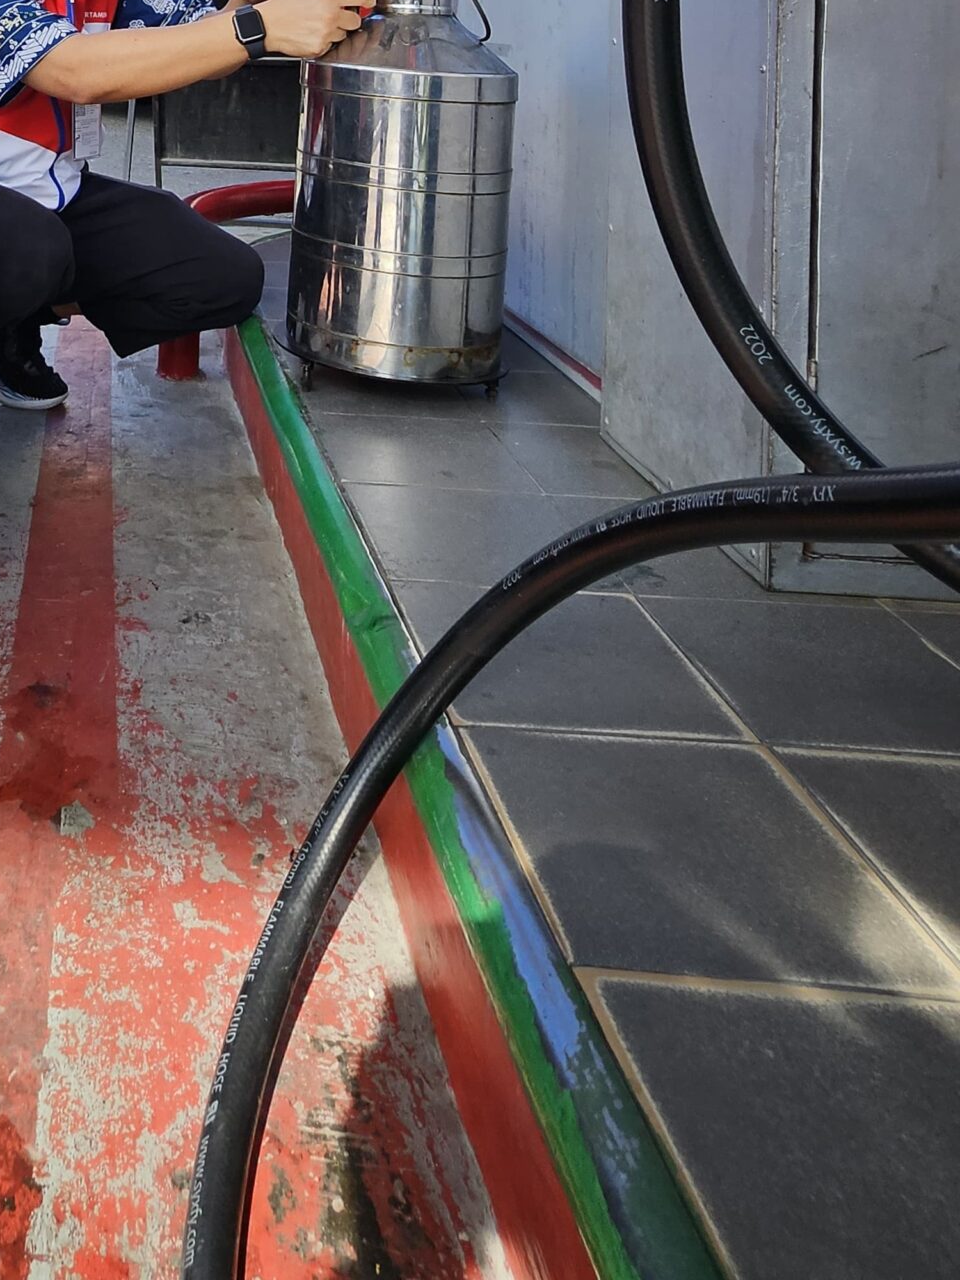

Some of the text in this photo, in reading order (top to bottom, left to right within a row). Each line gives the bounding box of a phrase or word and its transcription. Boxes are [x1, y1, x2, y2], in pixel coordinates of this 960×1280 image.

[784, 384, 862, 470] w.syxfy.com
[636, 500, 665, 520] LIQUID
[671, 488, 726, 512] FLAMMABLE
[733, 487, 771, 506] (19mm)
[283, 840, 313, 889] (19mm)
[245, 900, 284, 983] FLAMMABLE
[225, 994, 248, 1043] LIQUID
[212, 1052, 231, 1094] HOSE
